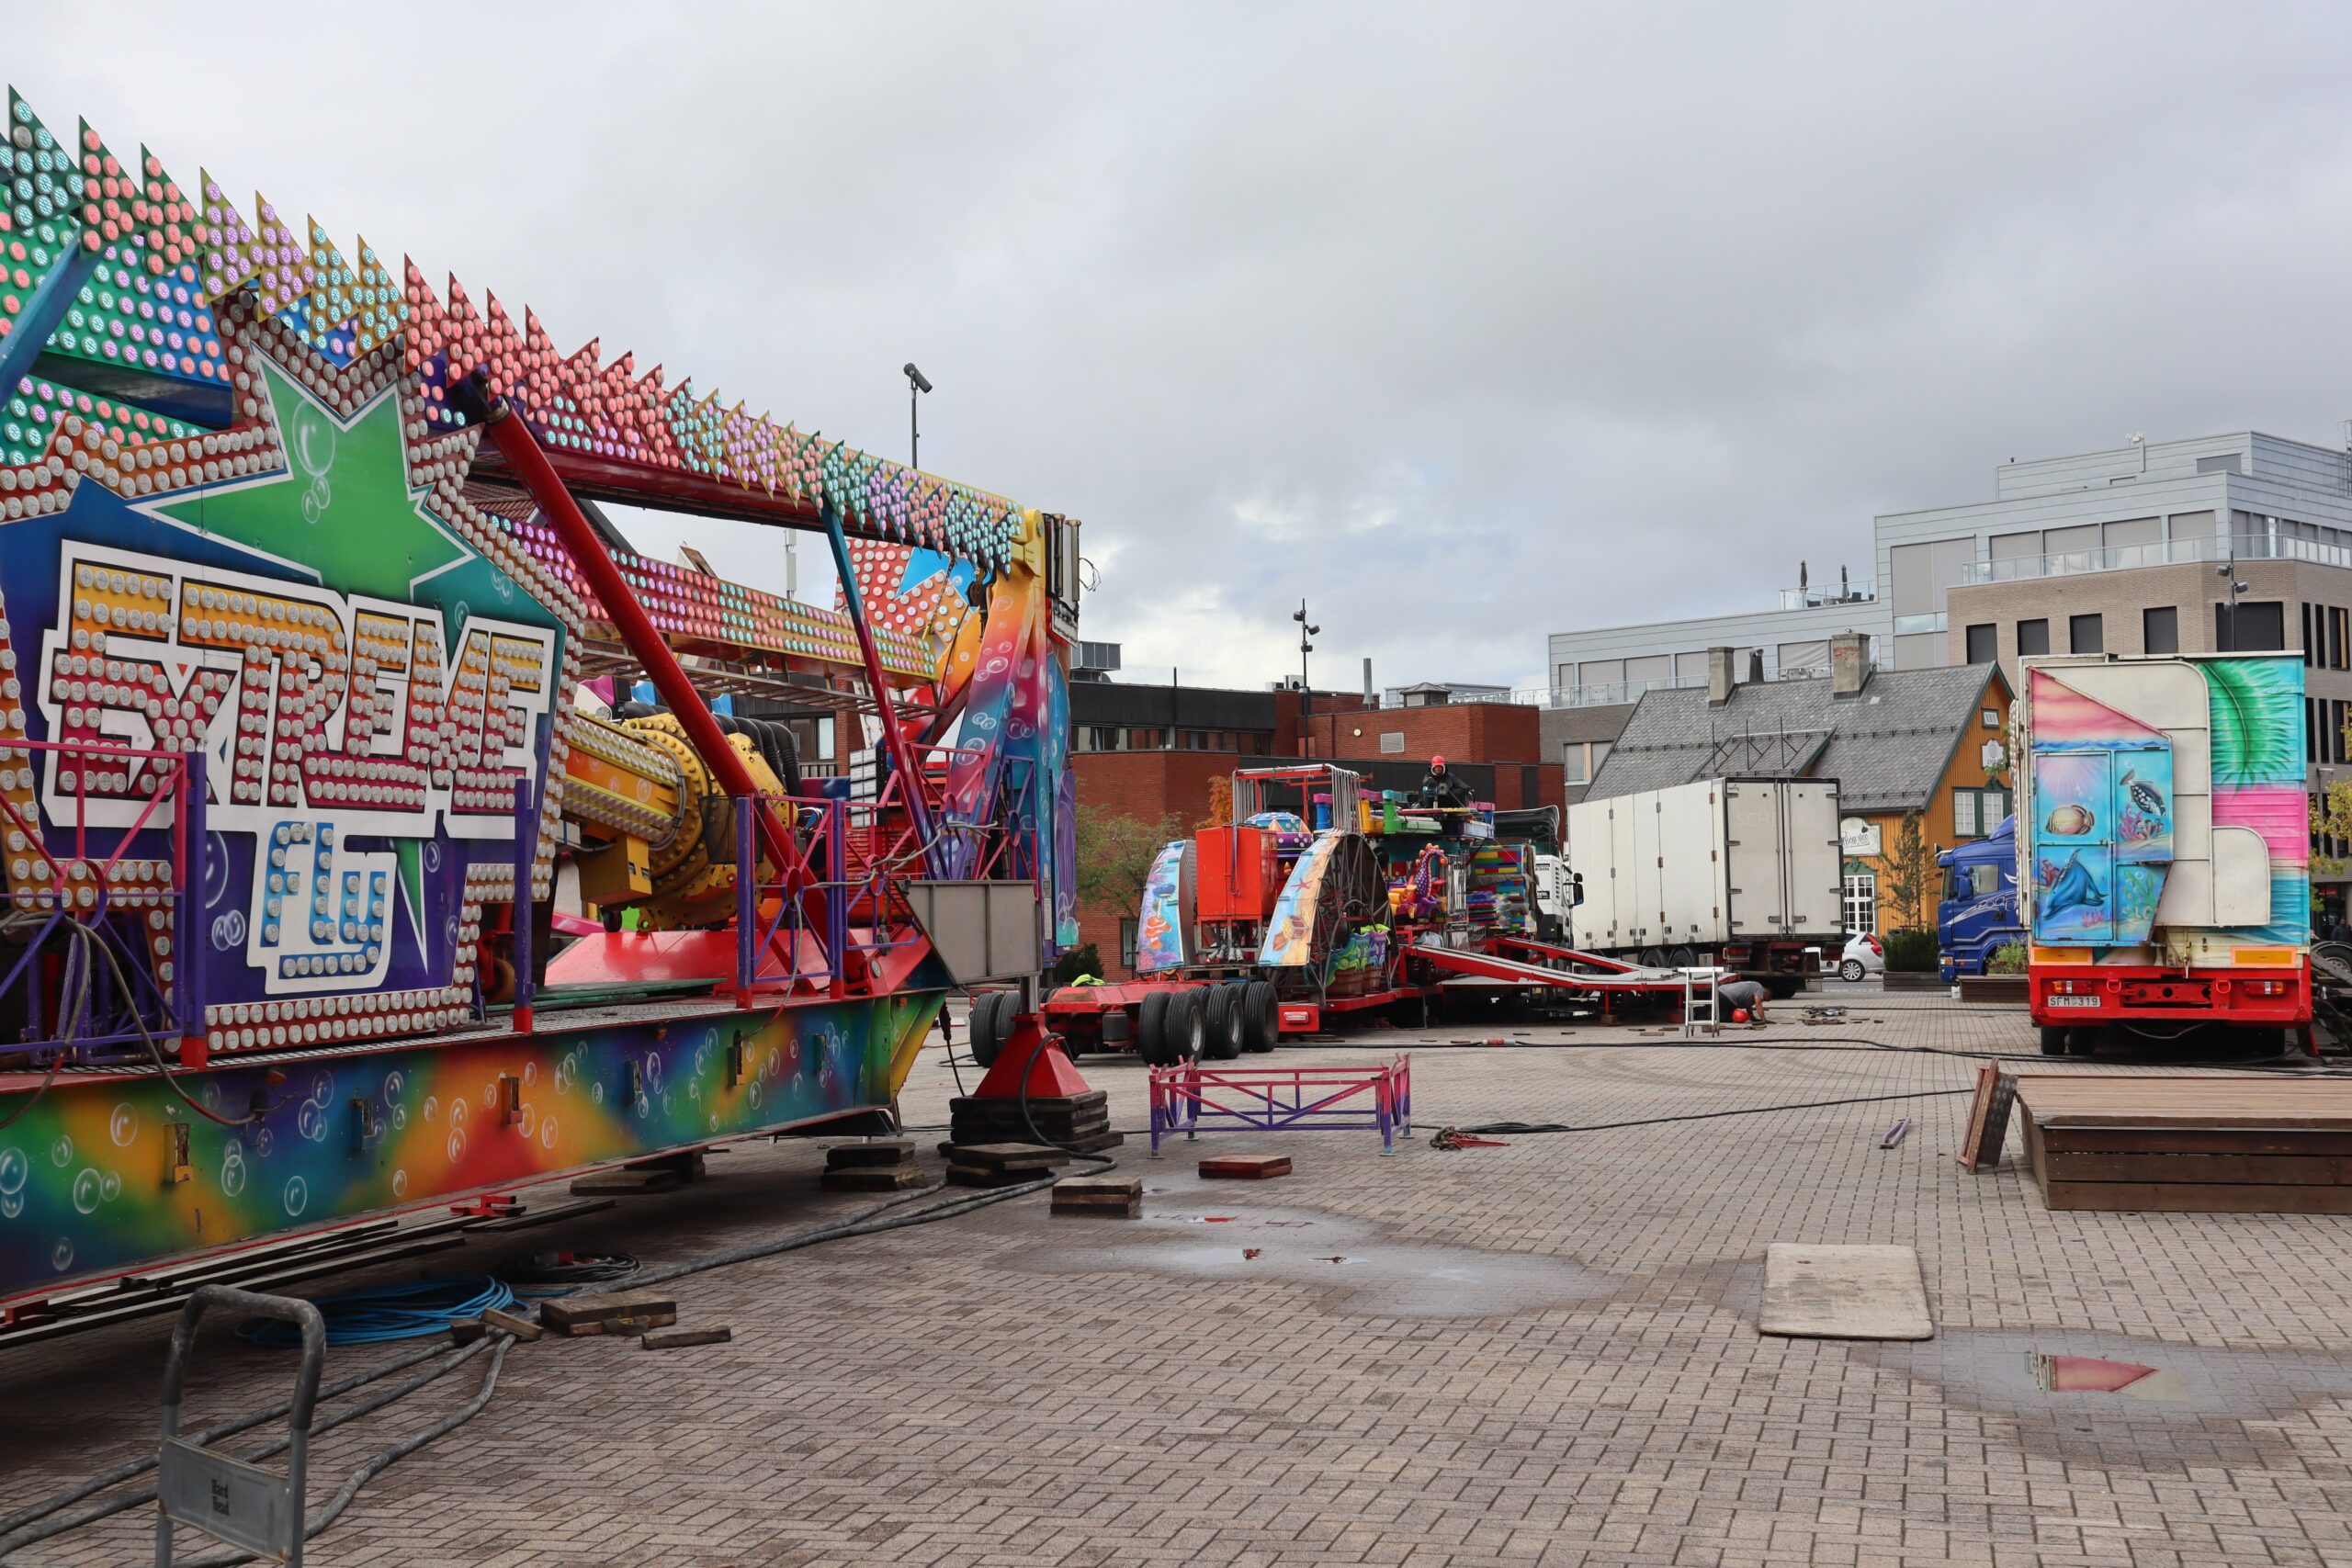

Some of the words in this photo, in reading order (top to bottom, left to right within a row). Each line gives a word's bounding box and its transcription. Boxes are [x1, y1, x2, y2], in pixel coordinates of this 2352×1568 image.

[50, 558, 548, 817] EXTREME
[2050, 997, 2071, 1007] SFM
[2078, 997, 2098, 1007] 319
[211, 1478, 229, 1499] Hard
